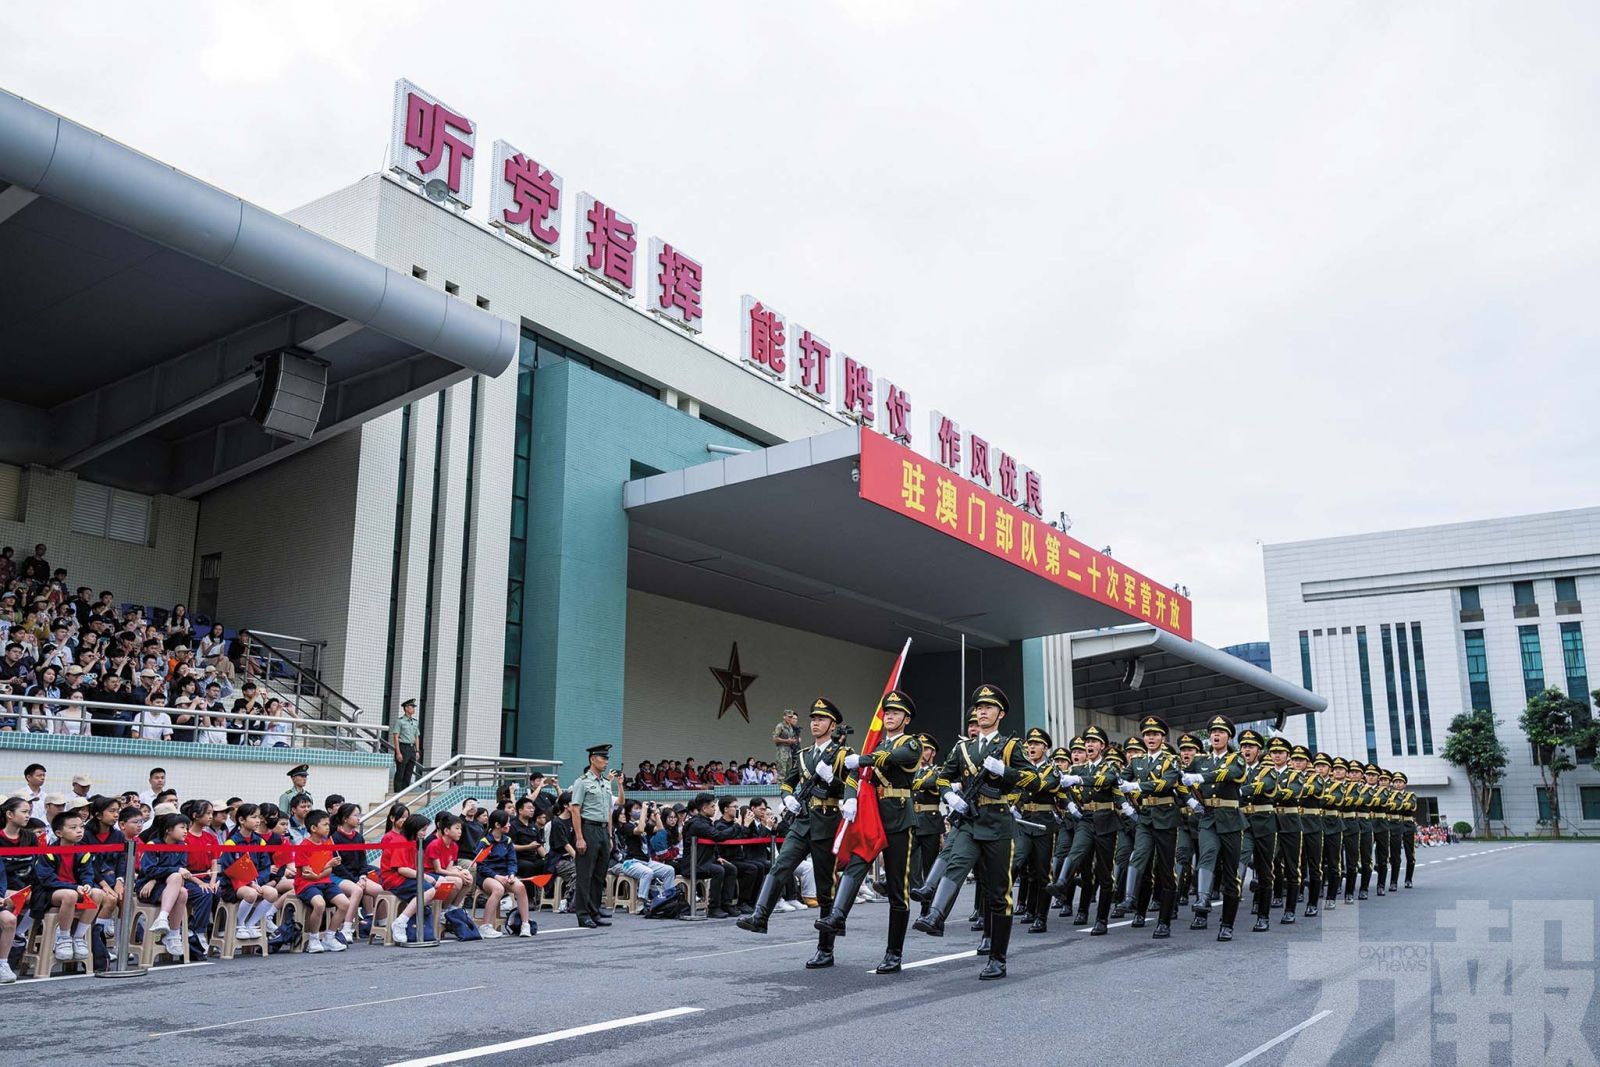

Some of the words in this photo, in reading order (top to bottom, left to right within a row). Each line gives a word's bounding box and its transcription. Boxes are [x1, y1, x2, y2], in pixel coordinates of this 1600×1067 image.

[404, 93, 703, 321] 听党指挥
[749, 301, 912, 444] 能打胜仗
[938, 416, 1042, 516] 作风优良
[901, 459, 1180, 630] 驻澳门部队第二十次军营开放
